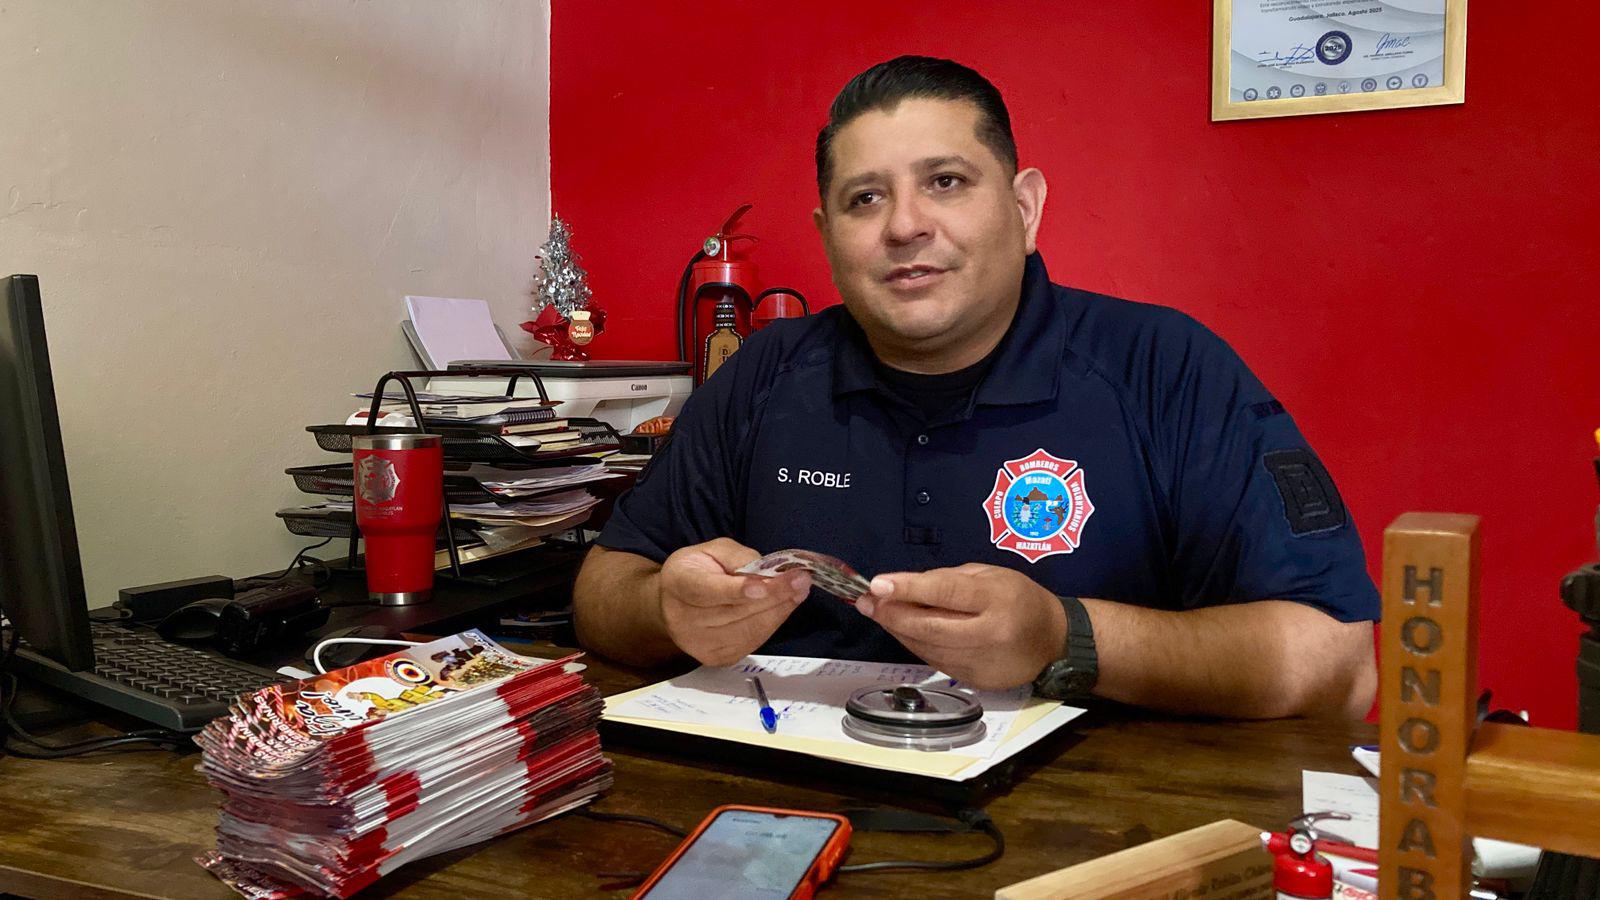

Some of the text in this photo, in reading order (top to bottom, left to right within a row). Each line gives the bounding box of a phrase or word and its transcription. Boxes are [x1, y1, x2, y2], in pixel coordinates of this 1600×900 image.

[630, 383, 648, 392] Canon
[777, 467, 792, 483] S.
[1019, 460, 1060, 473] BOMBEROS
[993, 490, 1004, 519] CUERPO
[1067, 481, 1085, 533] VOLUNTARIOS
[1396, 564, 1445, 900] HONORAB
